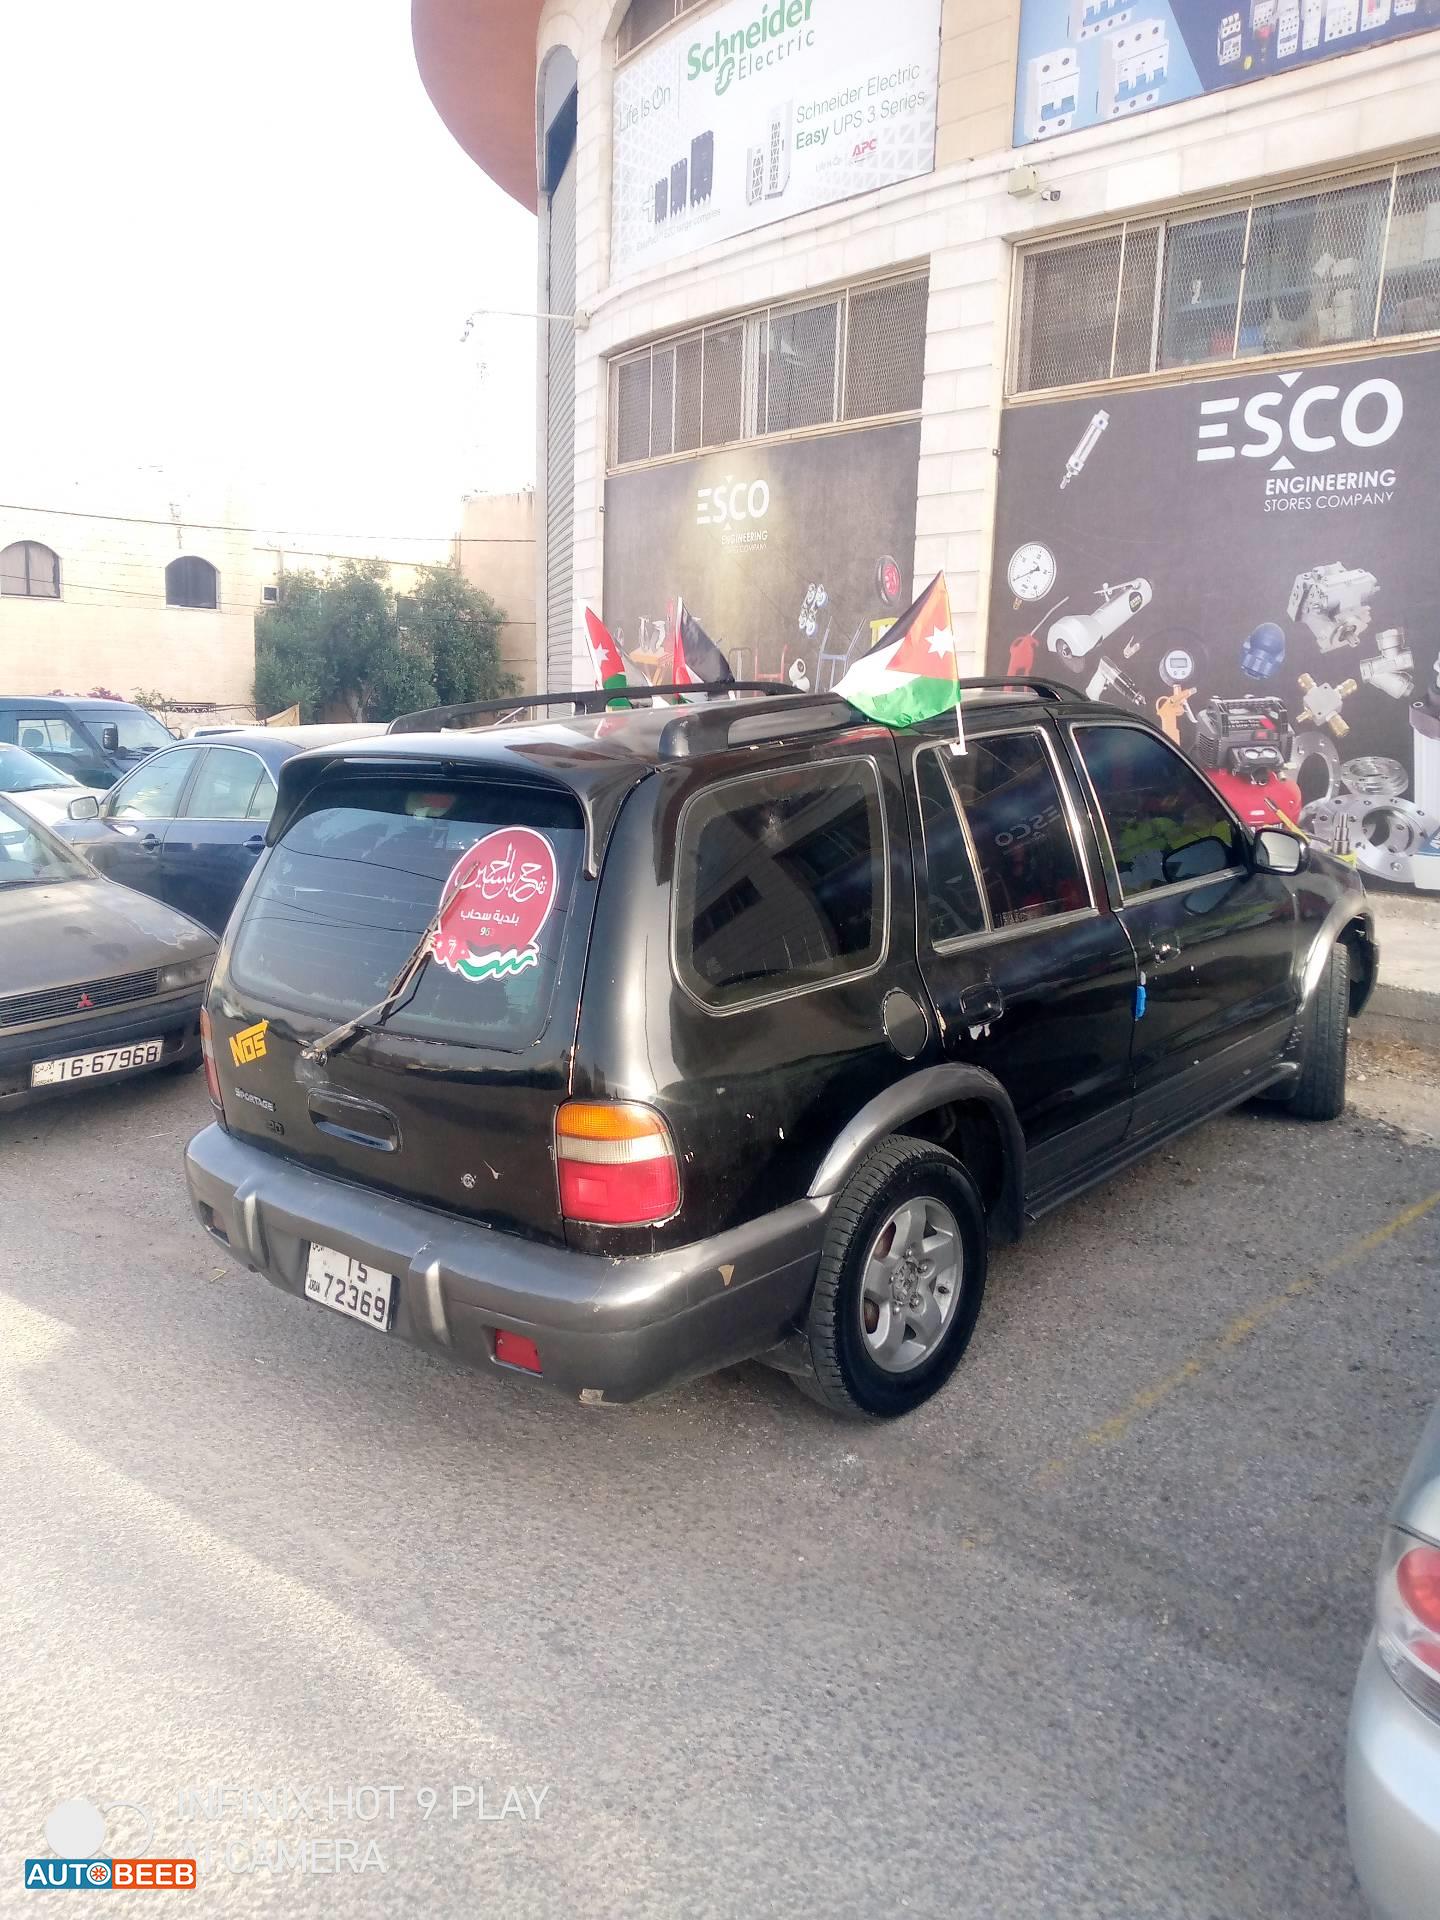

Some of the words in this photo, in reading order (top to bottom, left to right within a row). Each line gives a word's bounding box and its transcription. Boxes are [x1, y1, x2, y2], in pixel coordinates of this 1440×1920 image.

[687, 0, 813, 81] Schneider
[738, 29, 815, 81] Electric
[796, 86, 864, 123] Schneider
[867, 64, 920, 97] Electric
[796, 126, 829, 150] Easy
[833, 109, 863, 135] UPS
[867, 105, 876, 124] 3
[880, 91, 926, 119] Series
[852, 138, 878, 157] APC
[1197, 378, 1403, 461] ESCO
[697, 479, 770, 525] ESCO
[1264, 496, 1312, 512] STORES
[1315, 491, 1394, 509] COMPANY
[1265, 468, 1396, 496] ENGINEERING
[460, 908, 492, 921] سحاب
[493, 909, 520, 927] بلدية
[59, 1045, 159, 1080] 16-67968
[228, 1018, 269, 1068] NOS
[234, 1087, 275, 1112] SPORTAGE
[324, 1272, 386, 1323] 72369
